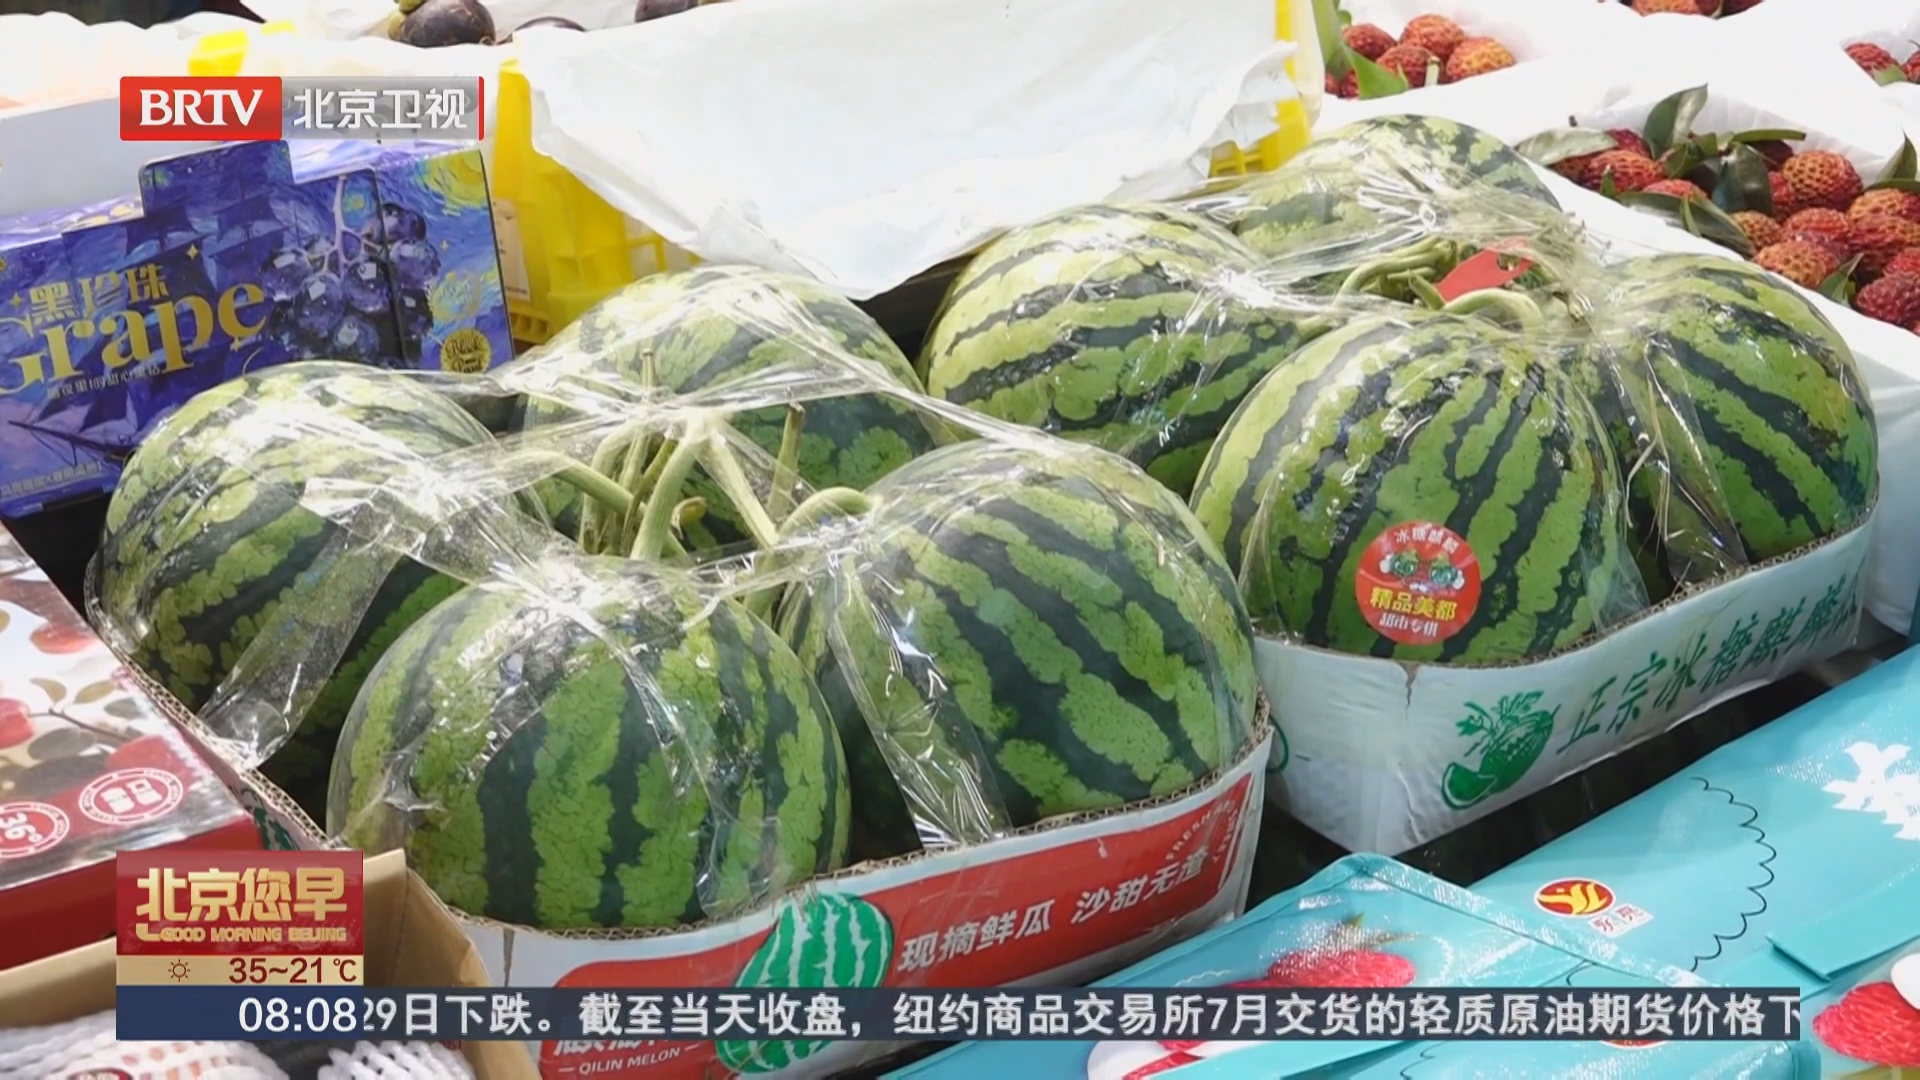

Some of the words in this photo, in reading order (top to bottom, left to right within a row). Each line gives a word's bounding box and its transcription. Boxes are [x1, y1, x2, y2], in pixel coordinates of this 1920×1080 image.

[29, 263, 170, 325] 黑珍珠
[0, 283, 267, 395] Grape
[897, 899, 1055, 972] 现摘鲜瓜
[579, 1057, 624, 1076] QILIN
[627, 1047, 682, 1068] MELON
